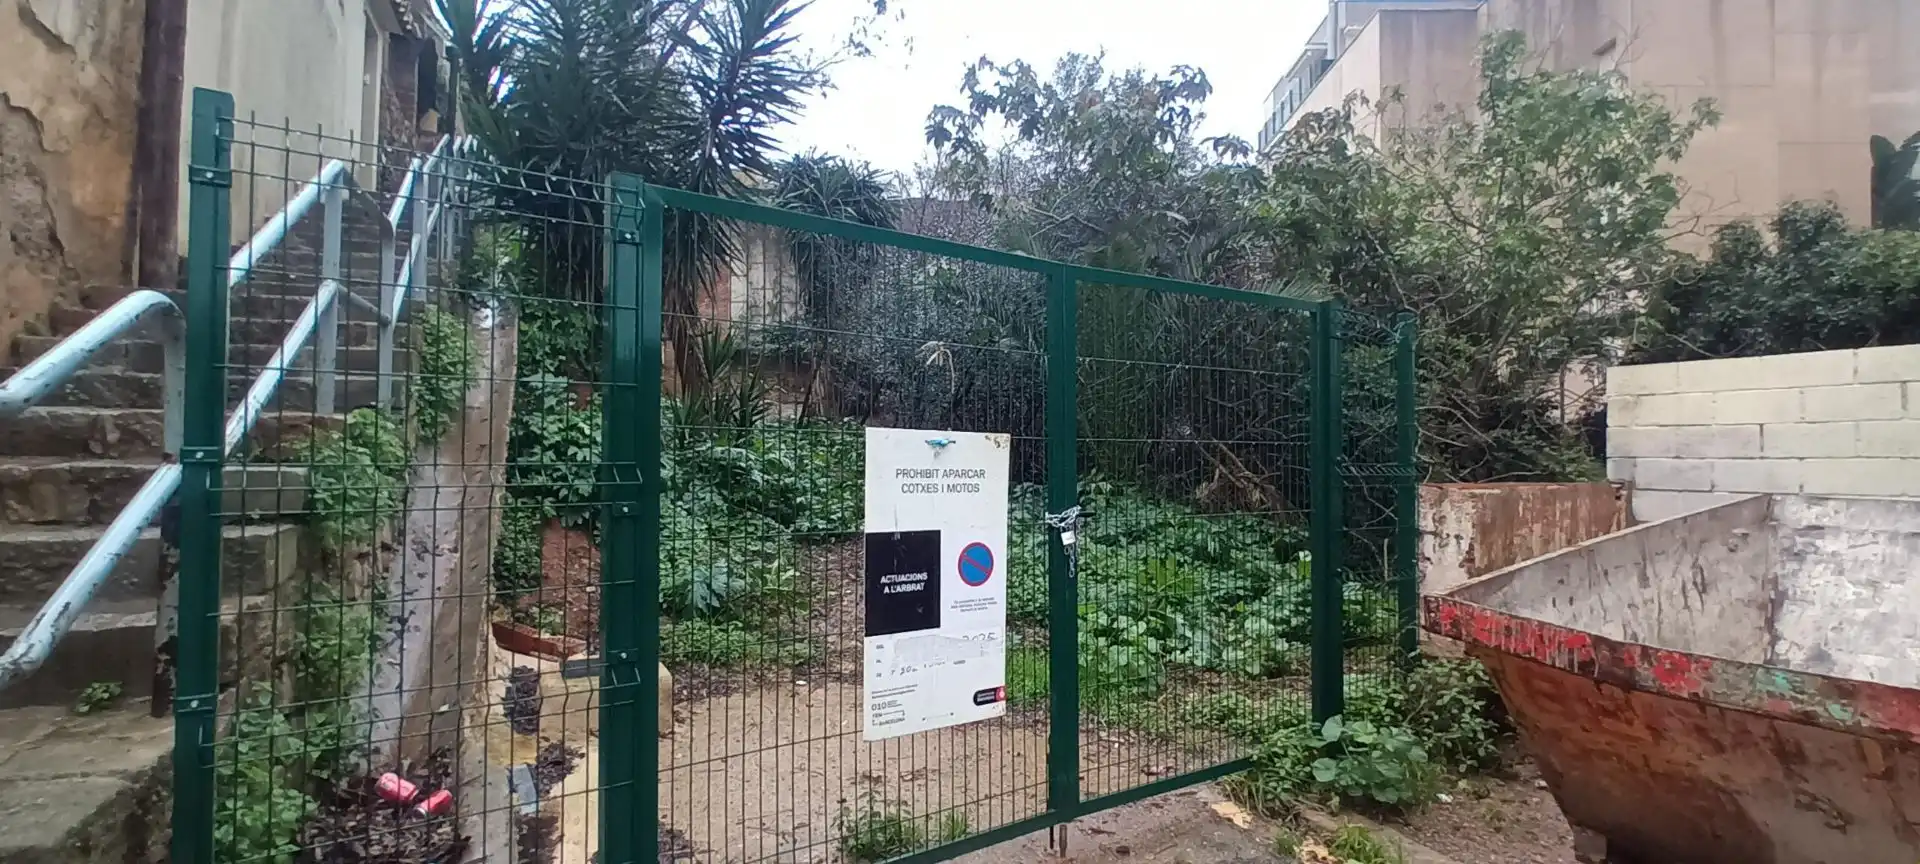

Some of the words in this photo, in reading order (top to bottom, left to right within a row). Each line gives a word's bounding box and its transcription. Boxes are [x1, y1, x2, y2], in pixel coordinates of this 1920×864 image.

[896, 468, 940, 479] PROHIBIT
[942, 469, 986, 479] APARCAR
[901, 483, 939, 493] COTXES
[946, 483, 980, 493] MOTOS
[880, 572, 928, 584] ACTUACIONS
[883, 586, 890, 594] A
[891, 582, 926, 593] L'ARBRAT
[871, 701, 887, 711] 010
